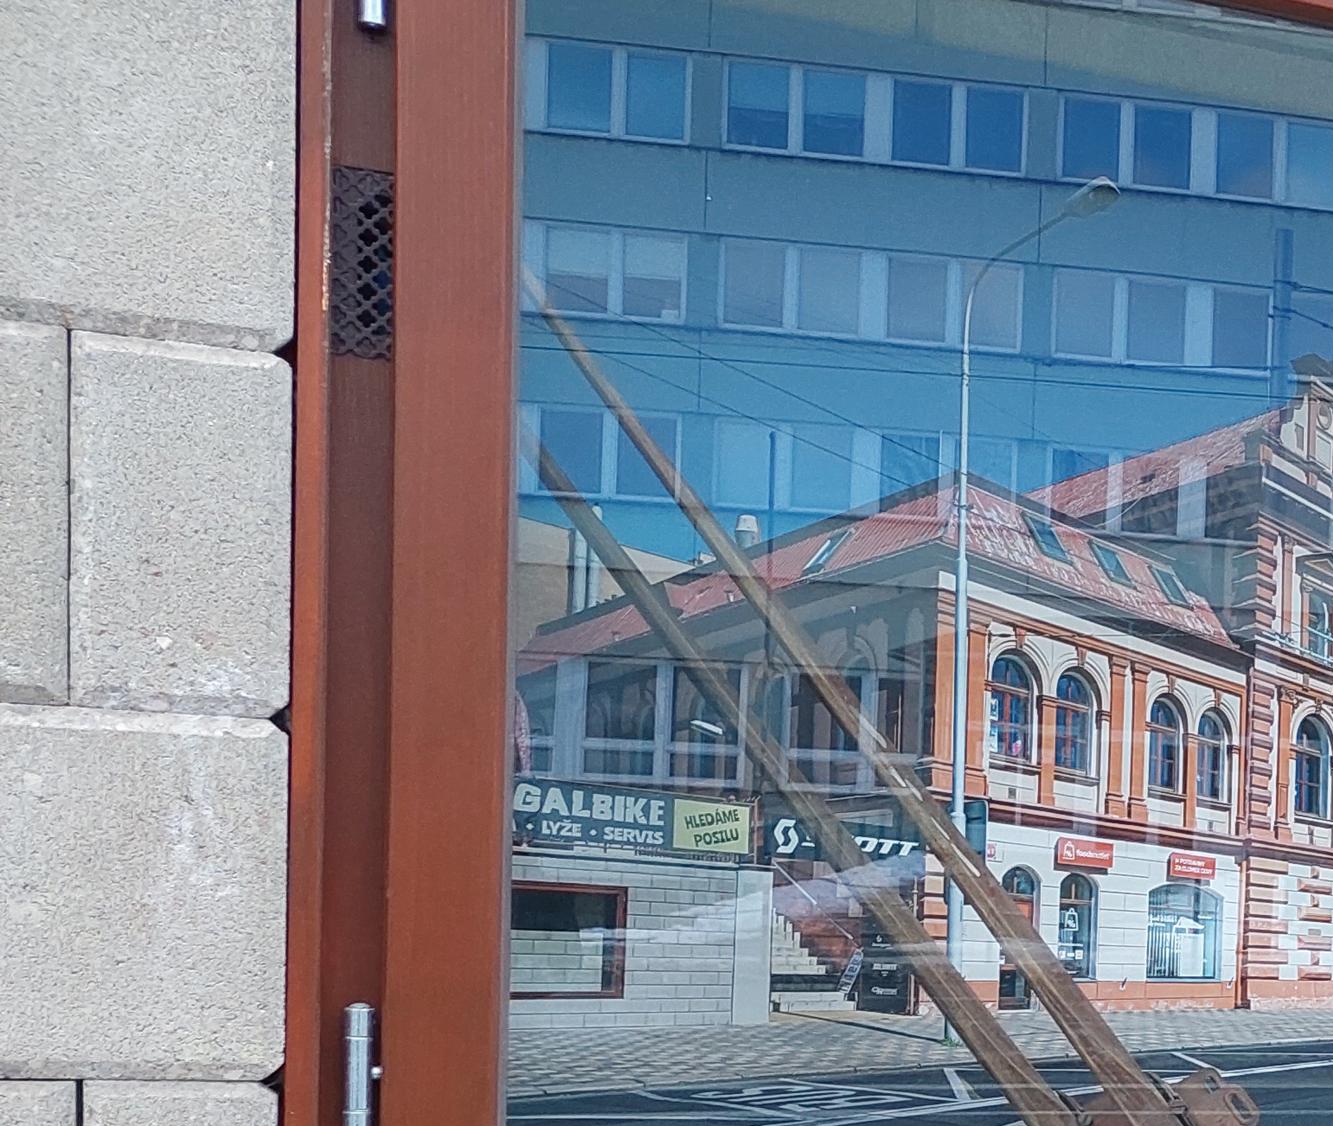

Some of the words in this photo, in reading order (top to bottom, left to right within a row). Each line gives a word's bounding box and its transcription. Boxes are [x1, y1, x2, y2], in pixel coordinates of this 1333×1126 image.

[684, 808, 740, 831] HLEDÁME
[541, 819, 582, 838] LYŽE
[603, 826, 664, 845] SERVIS
[694, 828, 739, 848] POSILU
